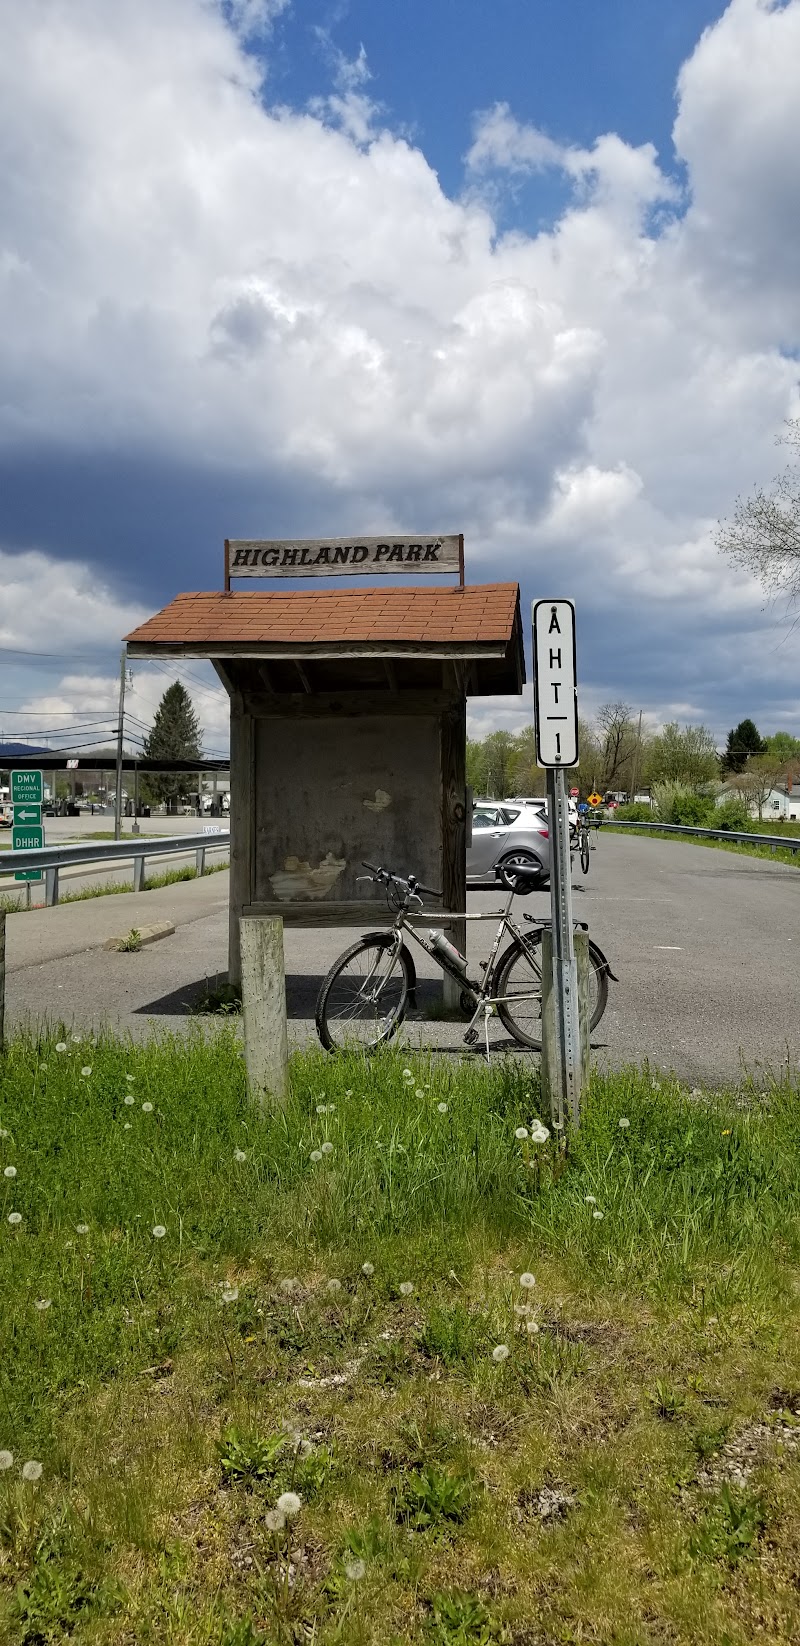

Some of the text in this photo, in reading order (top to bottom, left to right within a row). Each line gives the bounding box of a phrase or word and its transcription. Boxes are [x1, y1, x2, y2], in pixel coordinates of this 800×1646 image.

[232, 544, 442, 566] HIGHLAND PARK
[17, 775, 36, 783] DMV
[15, 837, 40, 847] DHHR
